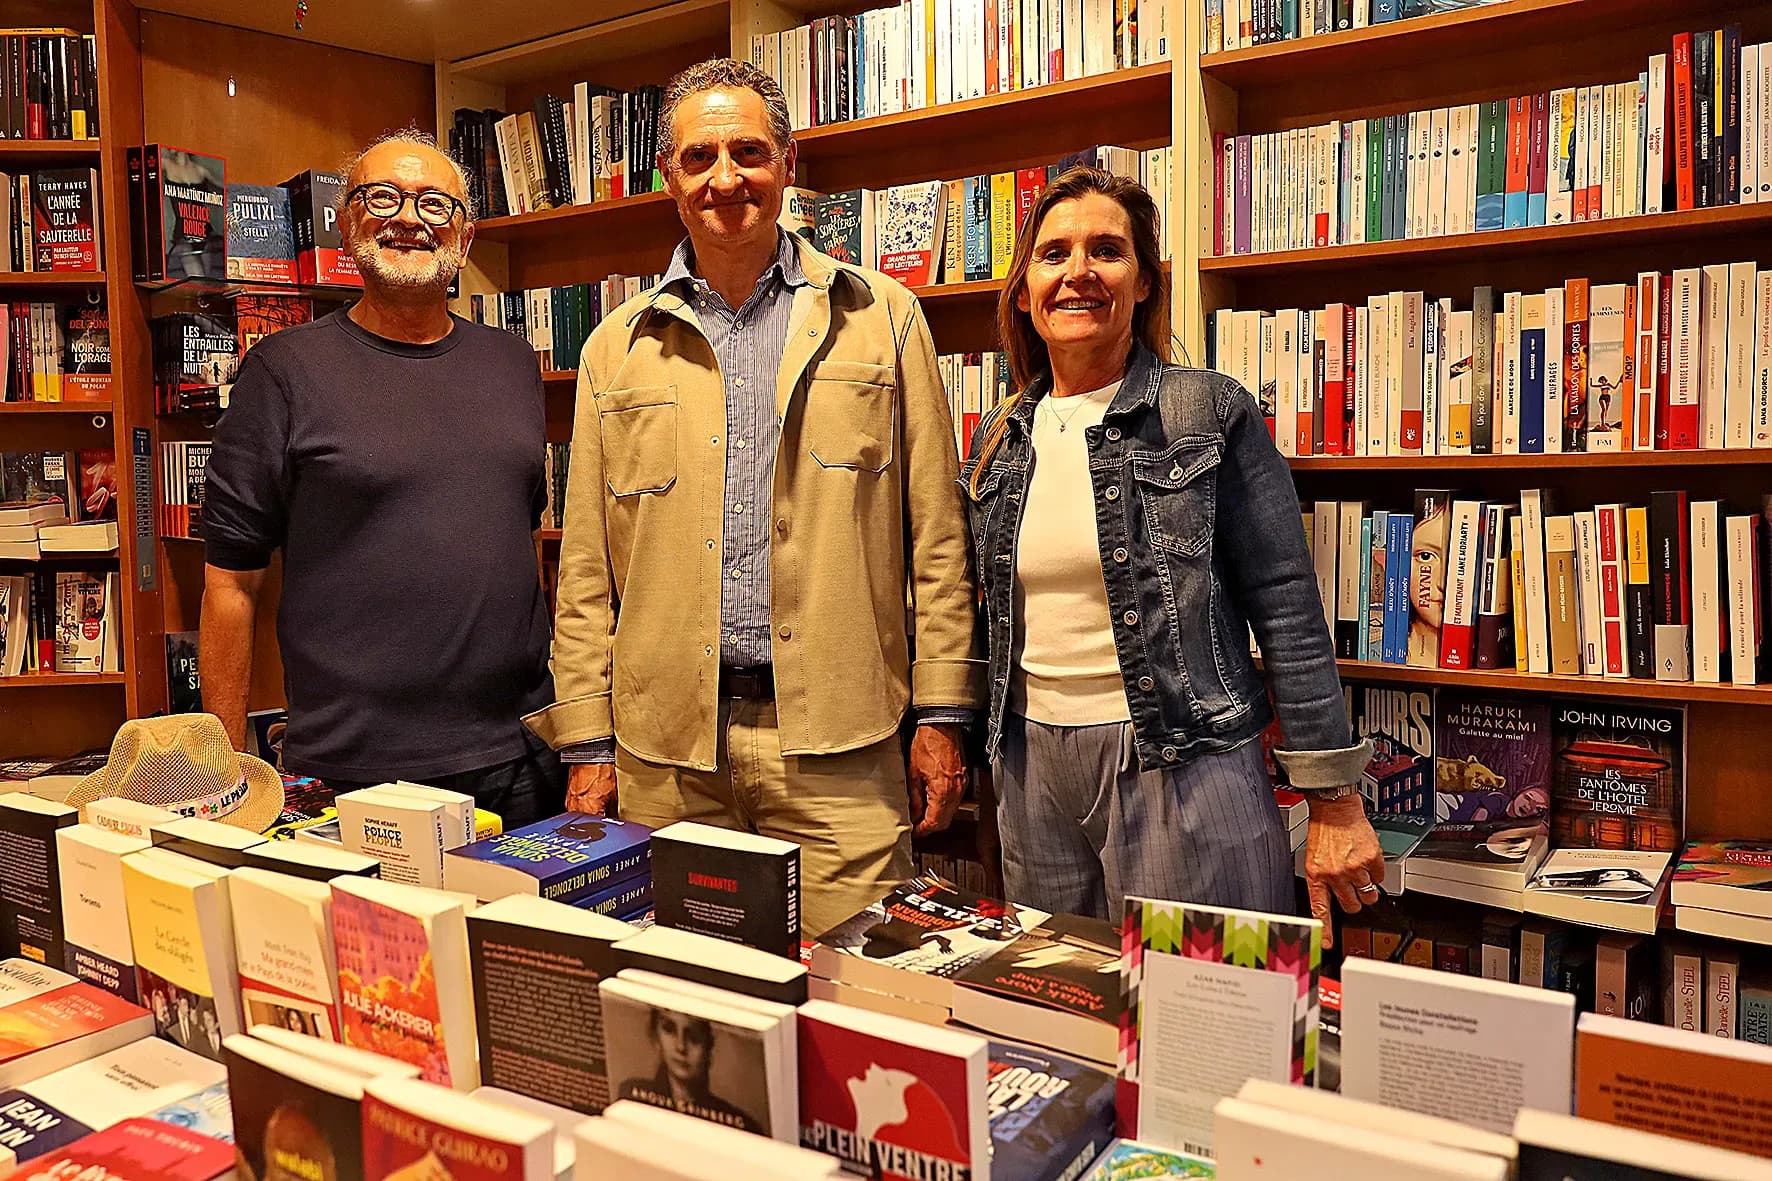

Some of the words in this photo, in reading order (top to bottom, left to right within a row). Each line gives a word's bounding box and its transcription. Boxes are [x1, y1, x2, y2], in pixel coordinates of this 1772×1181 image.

[39, 183, 61, 191] TERRY
[65, 181, 87, 190] HAYES
[48, 192, 80, 210] L'ANNÉE
[164, 184, 176, 196] ANA
[176, 185, 204, 204] MARTÍNEZ
[205, 192, 223, 207] MUÑOZ
[53, 213, 64, 225] DE
[66, 212, 77, 224] LA
[178, 202, 210, 222] VALENCE
[233, 203, 274, 221] PULIXI
[947, 200, 955, 242] FOLLETT
[966, 197, 976, 240] FOLLETT
[994, 192, 1004, 238] FOLLETT
[40, 229, 91, 244] SAUTERELLE
[184, 220, 206, 237] ROUGE
[244, 228, 268, 238] STELLA
[946, 248, 955, 269] KEN
[967, 246, 975, 268] KEN
[994, 242, 1004, 265] KEN
[183, 326, 199, 338] LES
[1571, 324, 1580, 353] PORTES
[72, 343, 94, 353] NOIR
[183, 338, 234, 352] ENTRAILLES
[183, 350, 195, 362] DE
[197, 351, 208, 362] LA
[1571, 355, 1580, 370] DES
[183, 363, 202, 375] NUIT
[1625, 355, 1633, 380] MOI?
[1509, 378, 1514, 386] DE
[1548, 362, 1557, 400] NAUFRAGÉS
[1570, 372, 1579, 403] MAISON
[1477, 402, 1486, 416] jour
[1570, 404, 1579, 415] LA
[1476, 417, 1484, 426] Un
[1458, 522, 1468, 556] MORIARTY
[1456, 558, 1465, 576] LIANE
[1419, 565, 1431, 609] FAYNE
[1455, 578, 1464, 617] MAINTENANT
[1461, 704, 1522, 719] HARUKI
[1559, 709, 1605, 726] JOHN
[1611, 715, 1672, 732] IRVING
[1358, 688, 1431, 758] JOURS
[1448, 715, 1536, 733] MURAKAMI
[1459, 728, 1490, 737] Galette
[1505, 733, 1524, 741] miel
[1605, 769, 1621, 780] LES
[1578, 789, 1594, 800] DE
[1580, 777, 1647, 795] FANTÔMES
[1590, 802, 1637, 816] JEROME
[364, 825, 401, 841] POLICE
[366, 835, 402, 849] PEOPLE
[489, 834, 590, 864] DELZONGLE
[492, 845, 551, 862] SONJA
[615, 854, 640, 872] APNÉE
[587, 864, 610, 883] SONJA
[543, 874, 585, 898] DELZONGLE
[621, 886, 645, 904] APNÉE
[596, 897, 617, 915] SONJA
[1681, 966, 1695, 996] STEEL
[1716, 973, 1730, 1003] STEEL
[342, 989, 372, 1015] JULIE
[1681, 998, 1695, 1032] Danielle
[1715, 1005, 1729, 1039] Danielle
[813, 1119, 871, 1164] PLEIN
[877, 1140, 971, 1181] VENTRE
